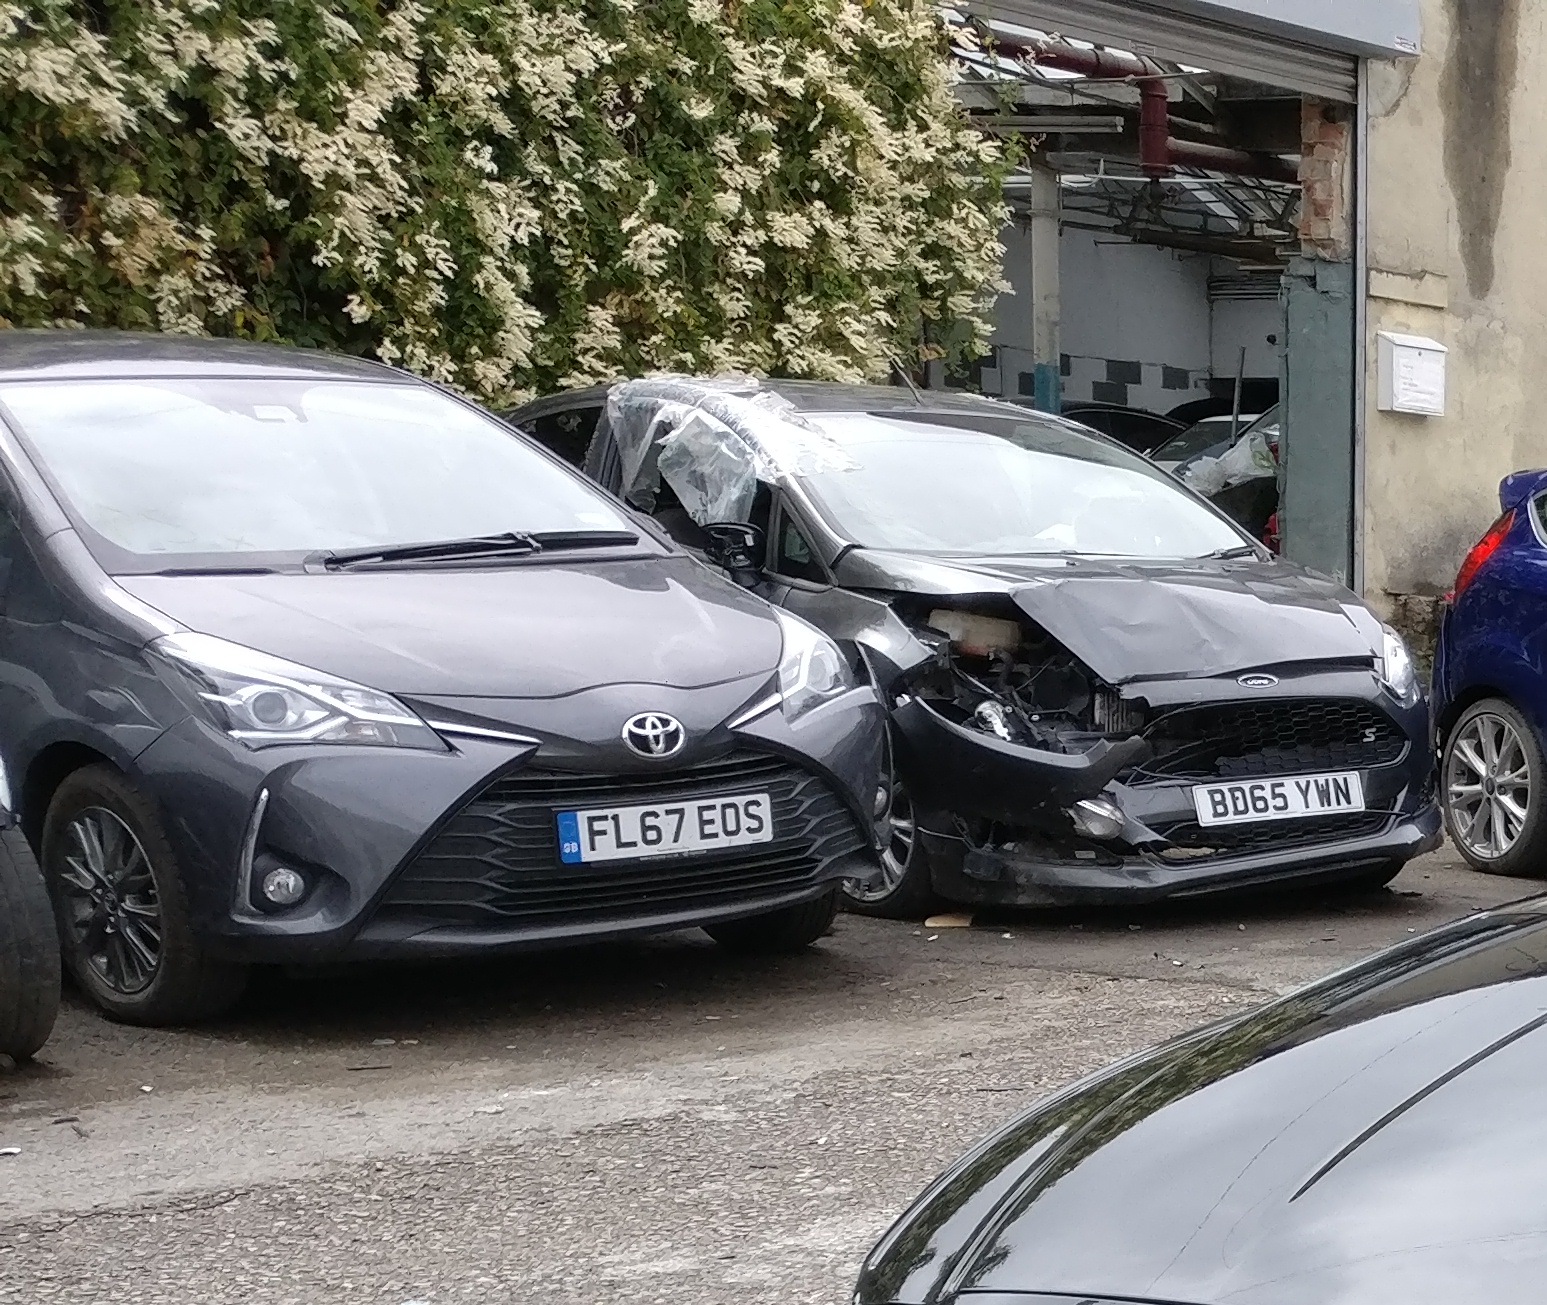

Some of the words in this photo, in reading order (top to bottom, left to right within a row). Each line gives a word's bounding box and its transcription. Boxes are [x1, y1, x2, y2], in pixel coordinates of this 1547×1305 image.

[1207, 781, 1289, 819] BD65
[1295, 777, 1352, 809] YWN
[586, 807, 686, 851] FL67
